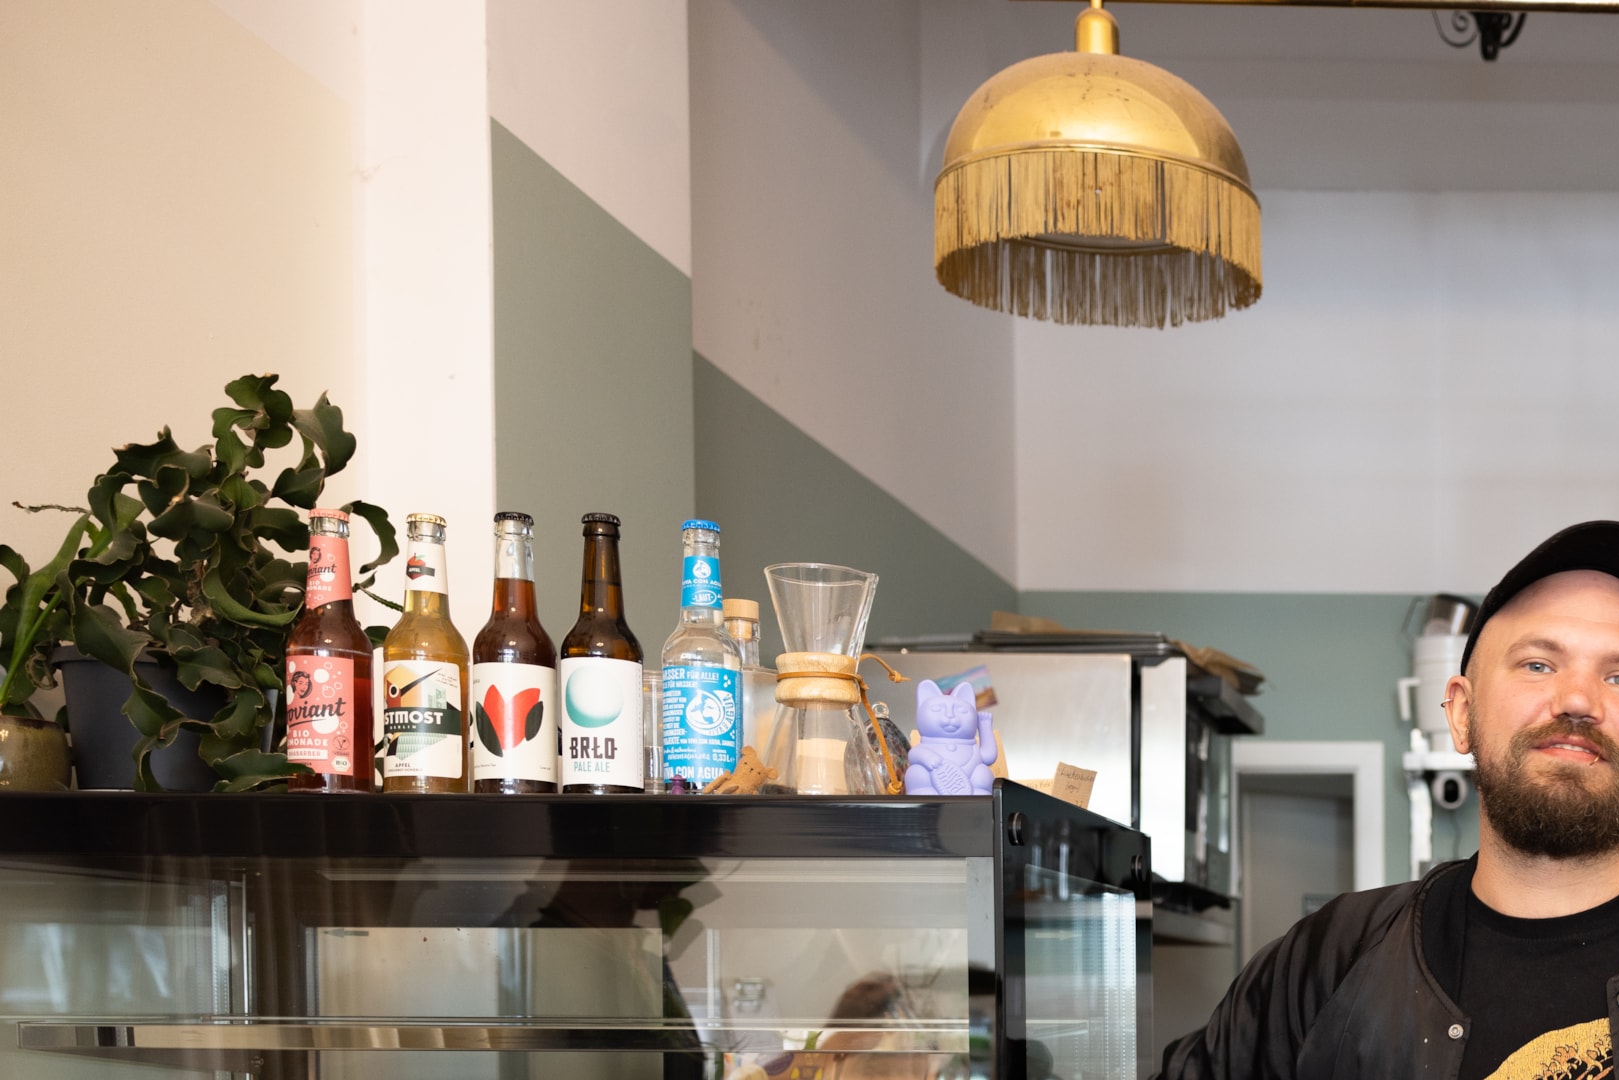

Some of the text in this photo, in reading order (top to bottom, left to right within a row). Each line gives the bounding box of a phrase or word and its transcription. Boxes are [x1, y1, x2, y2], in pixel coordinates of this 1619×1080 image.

[292, 729, 310, 738] BIO
[574, 761, 611, 773] PALE ALE
